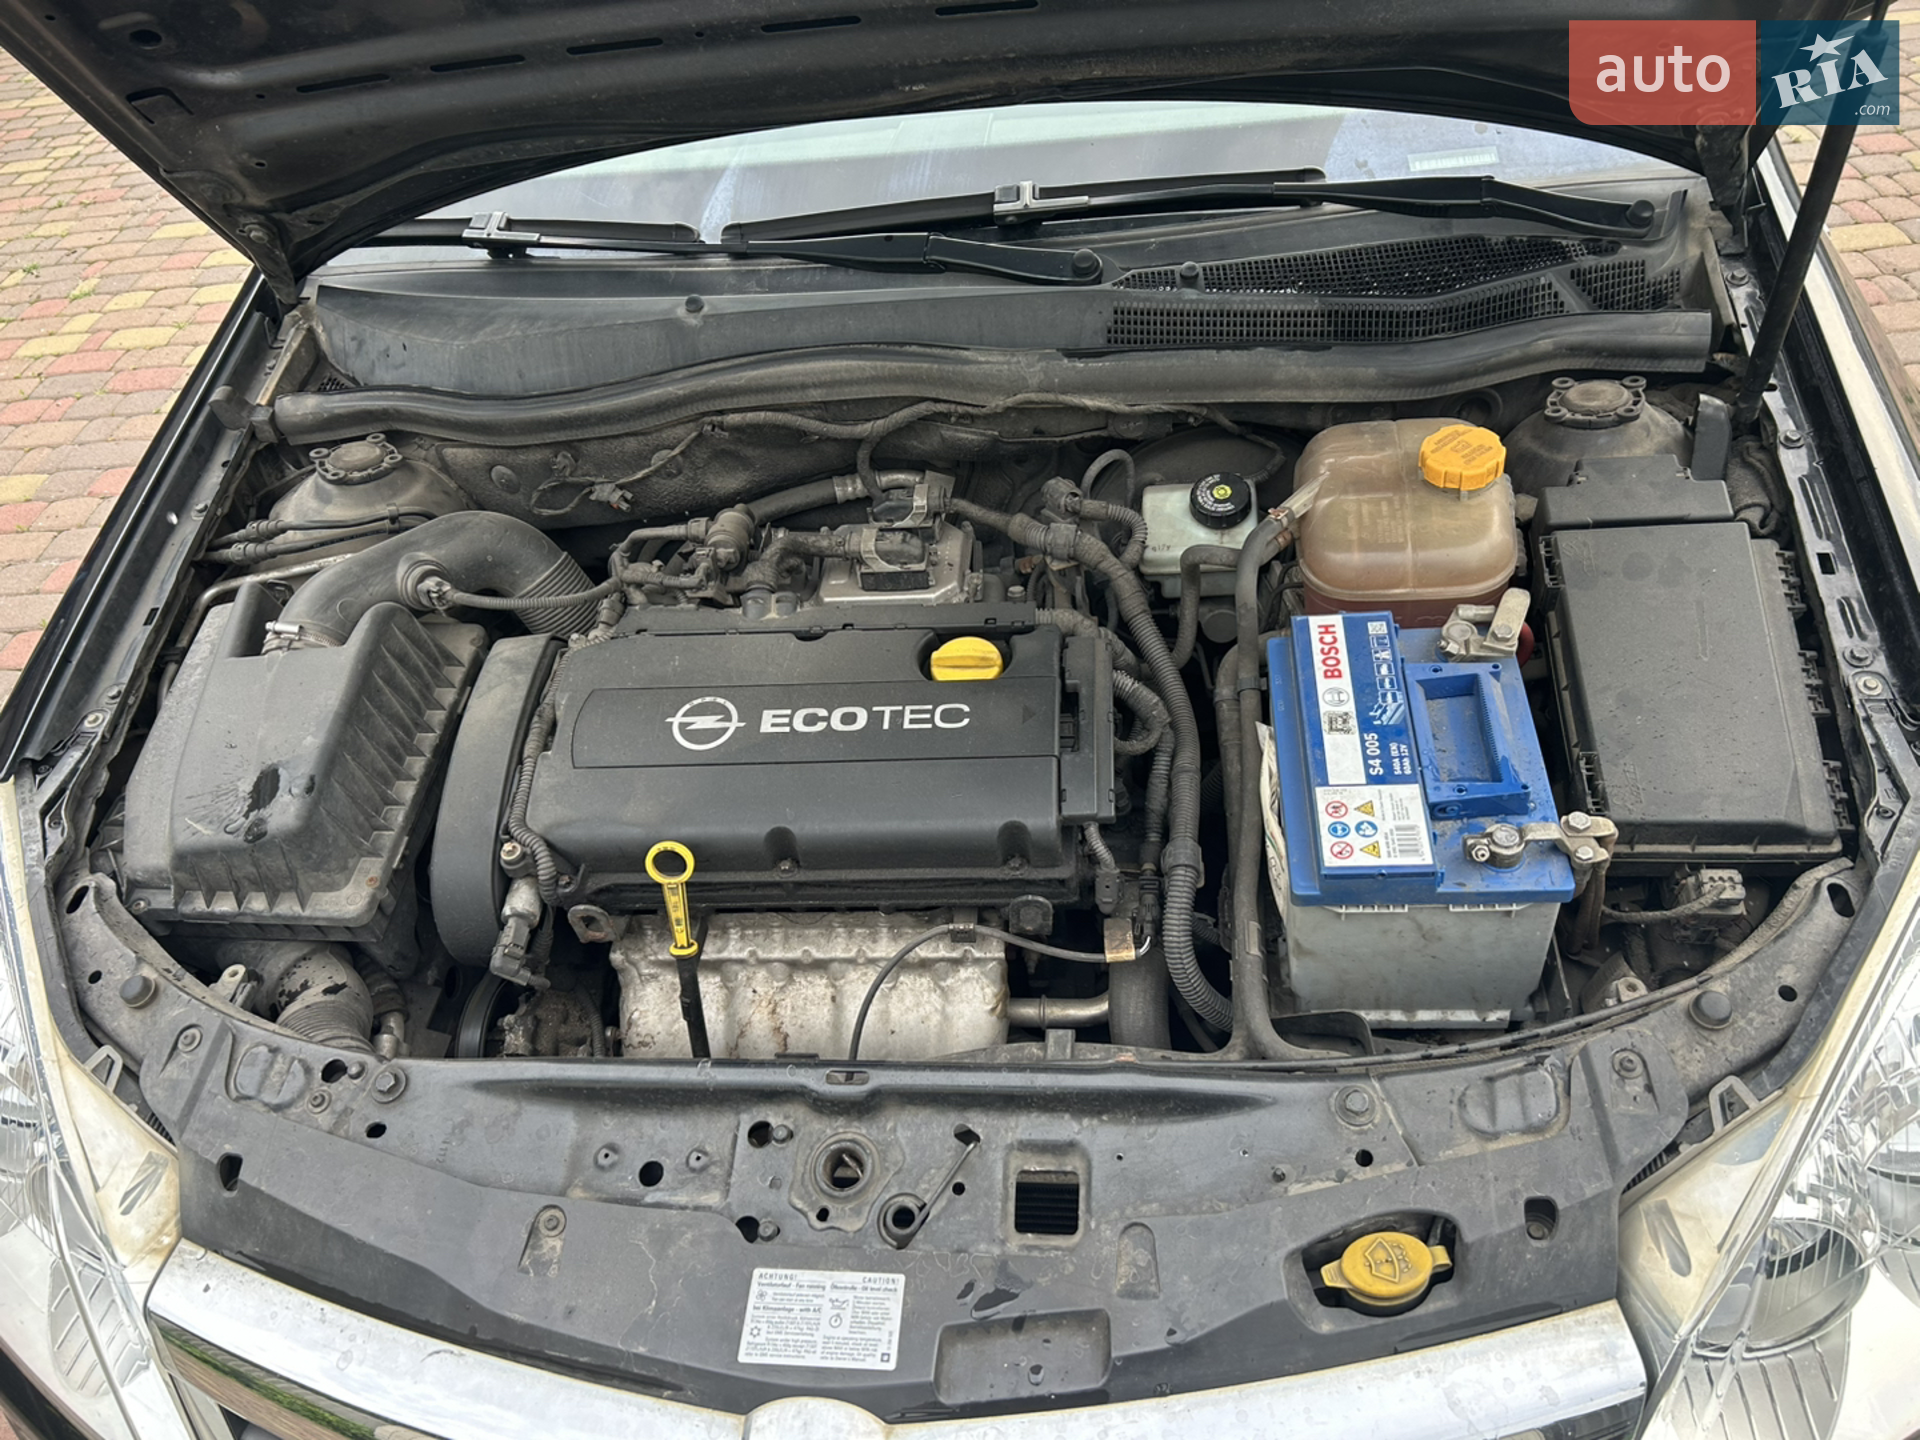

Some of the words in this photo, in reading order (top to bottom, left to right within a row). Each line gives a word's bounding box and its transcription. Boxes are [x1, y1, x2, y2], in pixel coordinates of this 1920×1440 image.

[1317, 623, 1342, 679] BOSCH
[759, 703, 971, 733] ECOTEC
[1363, 732, 1381, 756] 005
[1367, 758, 1384, 776] S4
[758, 1272, 797, 1280] ACHTUNG!
[862, 1276, 899, 1284] CAUTION!
